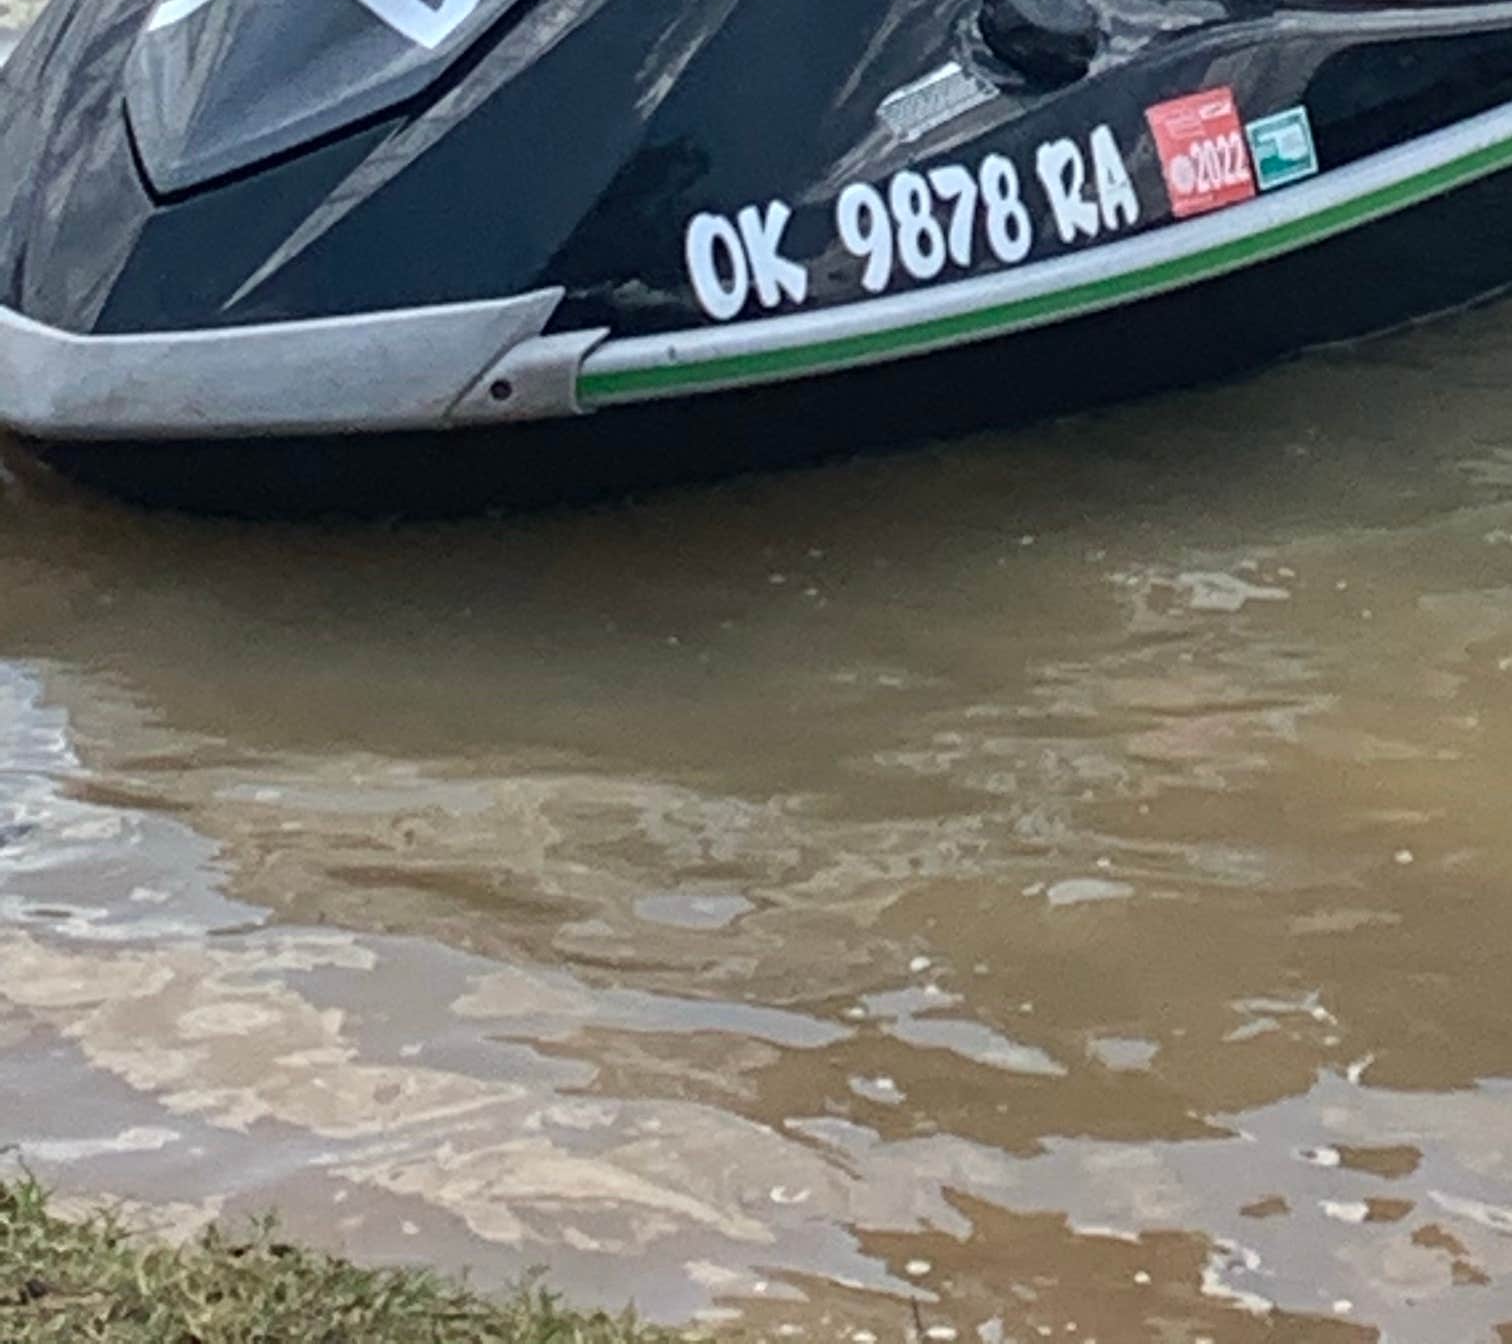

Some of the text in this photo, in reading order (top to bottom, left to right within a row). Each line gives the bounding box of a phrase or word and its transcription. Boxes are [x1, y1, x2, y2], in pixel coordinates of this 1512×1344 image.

[685, 124, 1139, 322] OK 9878 RA
[1189, 132, 1249, 193] 2022
